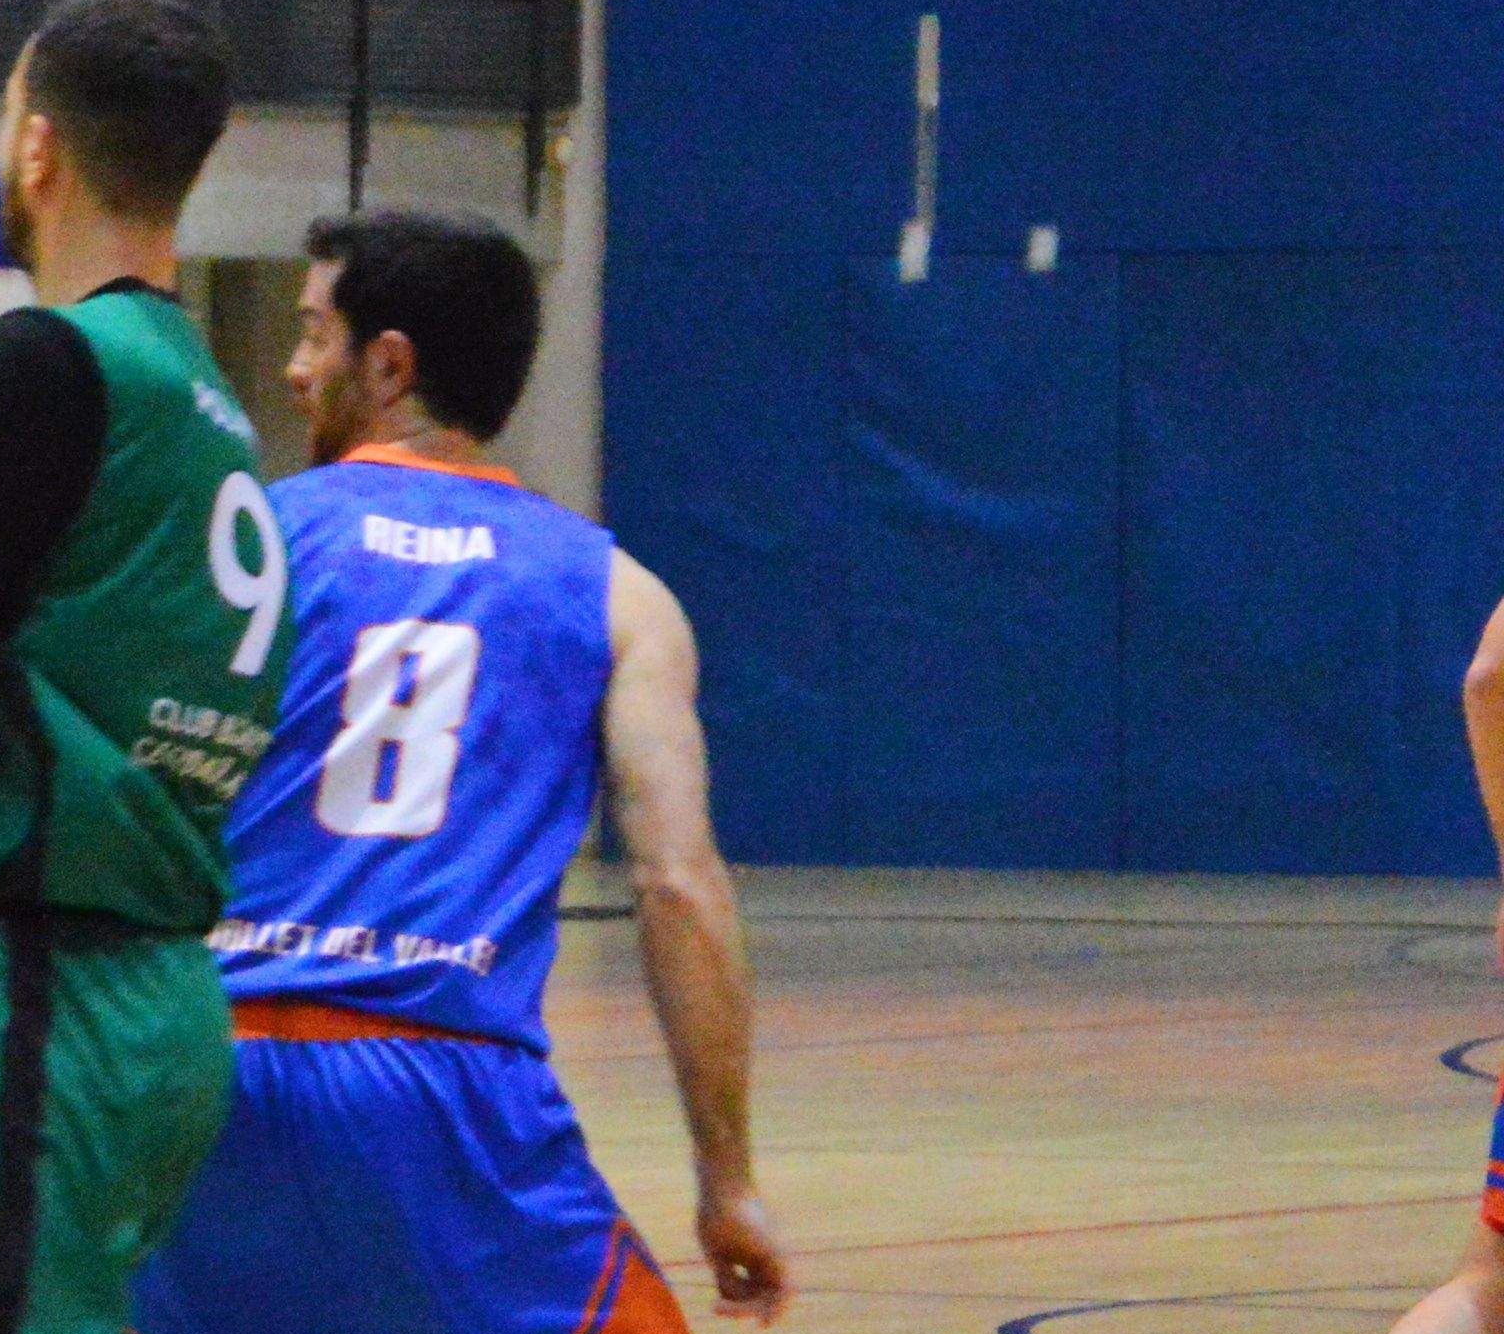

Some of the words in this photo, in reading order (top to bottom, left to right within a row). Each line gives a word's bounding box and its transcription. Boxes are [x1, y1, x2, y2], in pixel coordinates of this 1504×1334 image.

[208, 470, 288, 676] 9
[362, 514, 496, 565] REINA
[314, 618, 484, 839] 8
